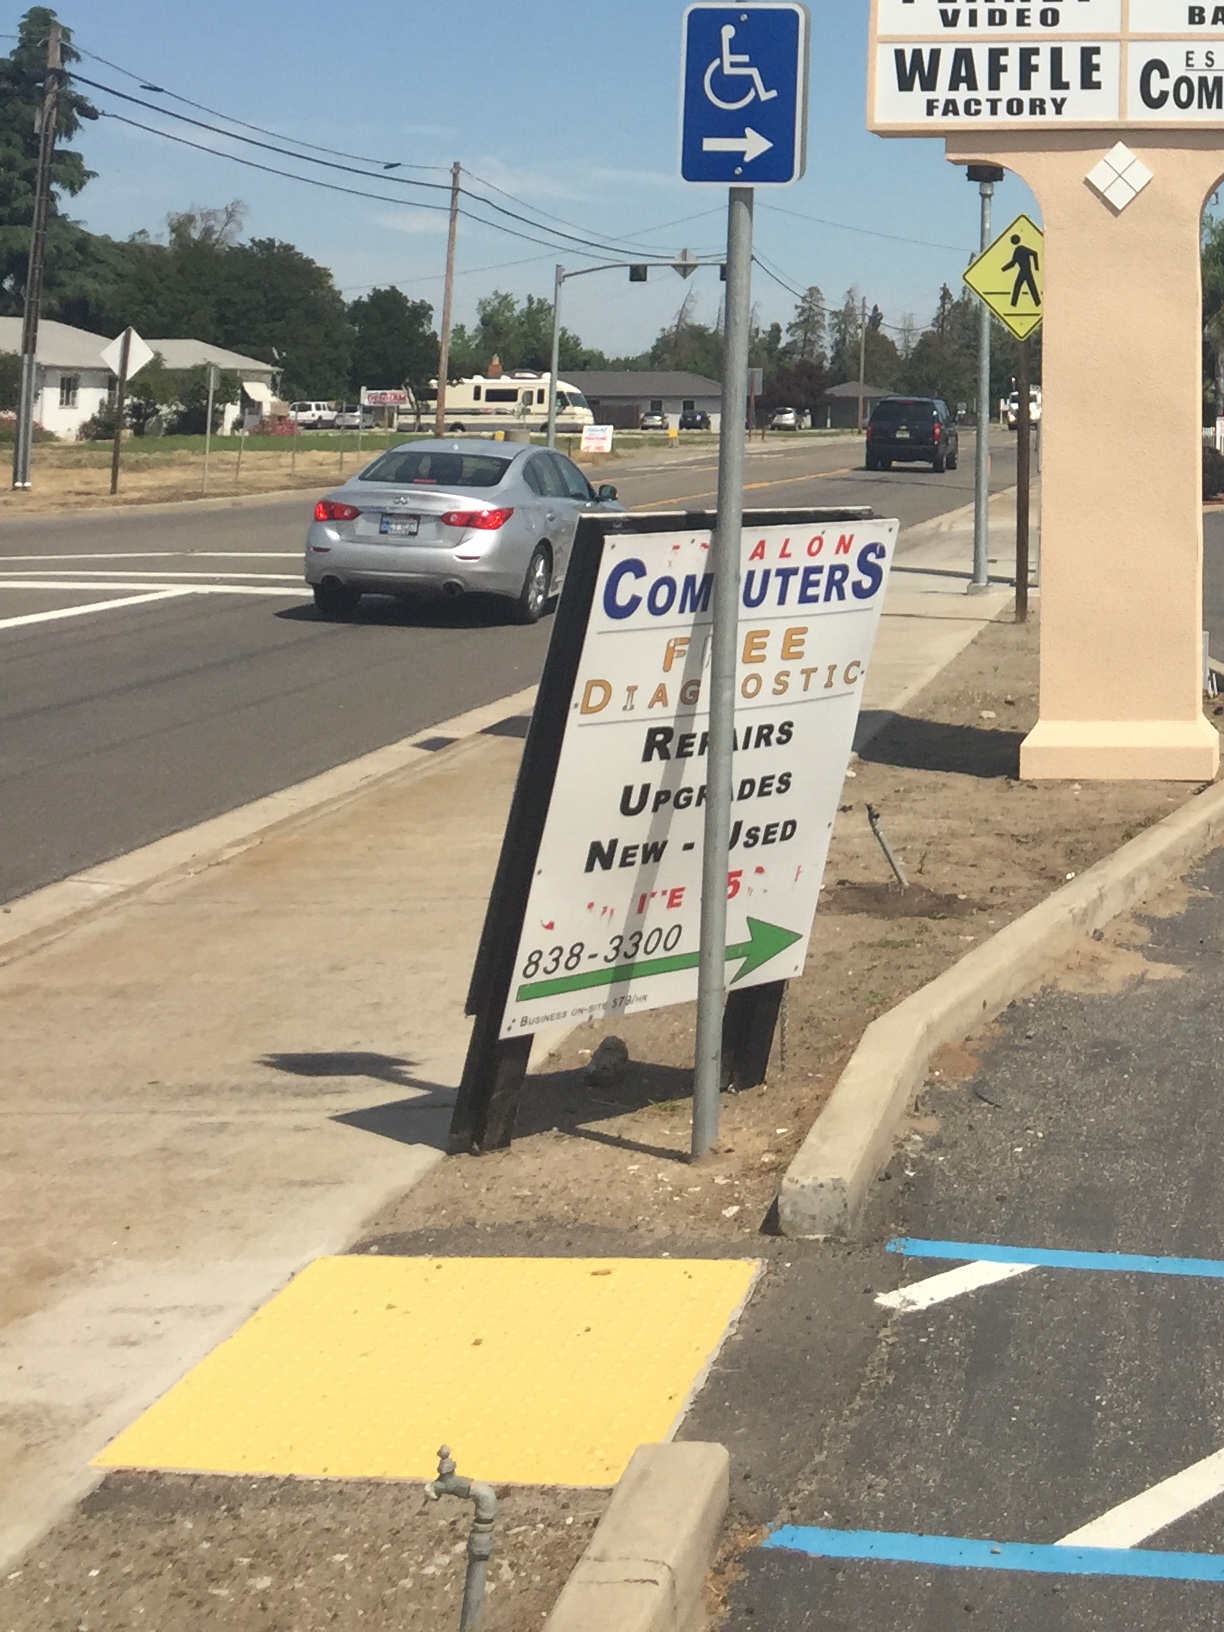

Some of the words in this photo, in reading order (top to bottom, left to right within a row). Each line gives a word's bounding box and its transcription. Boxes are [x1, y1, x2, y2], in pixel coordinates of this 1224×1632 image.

[939, 8, 1060, 27] VIDEO
[894, 46, 1101, 92] WAFFLE
[926, 98, 1067, 117] FACTORY
[603, 542, 886, 620] COMUTERS
[663, 626, 808, 672] FEE
[580, 660, 860, 714] DIAGOSTIC
[584, 838, 668, 873] NEW
[522, 924, 683, 979] 838-3300
[520, 1010, 567, 1027] BUSINESS
